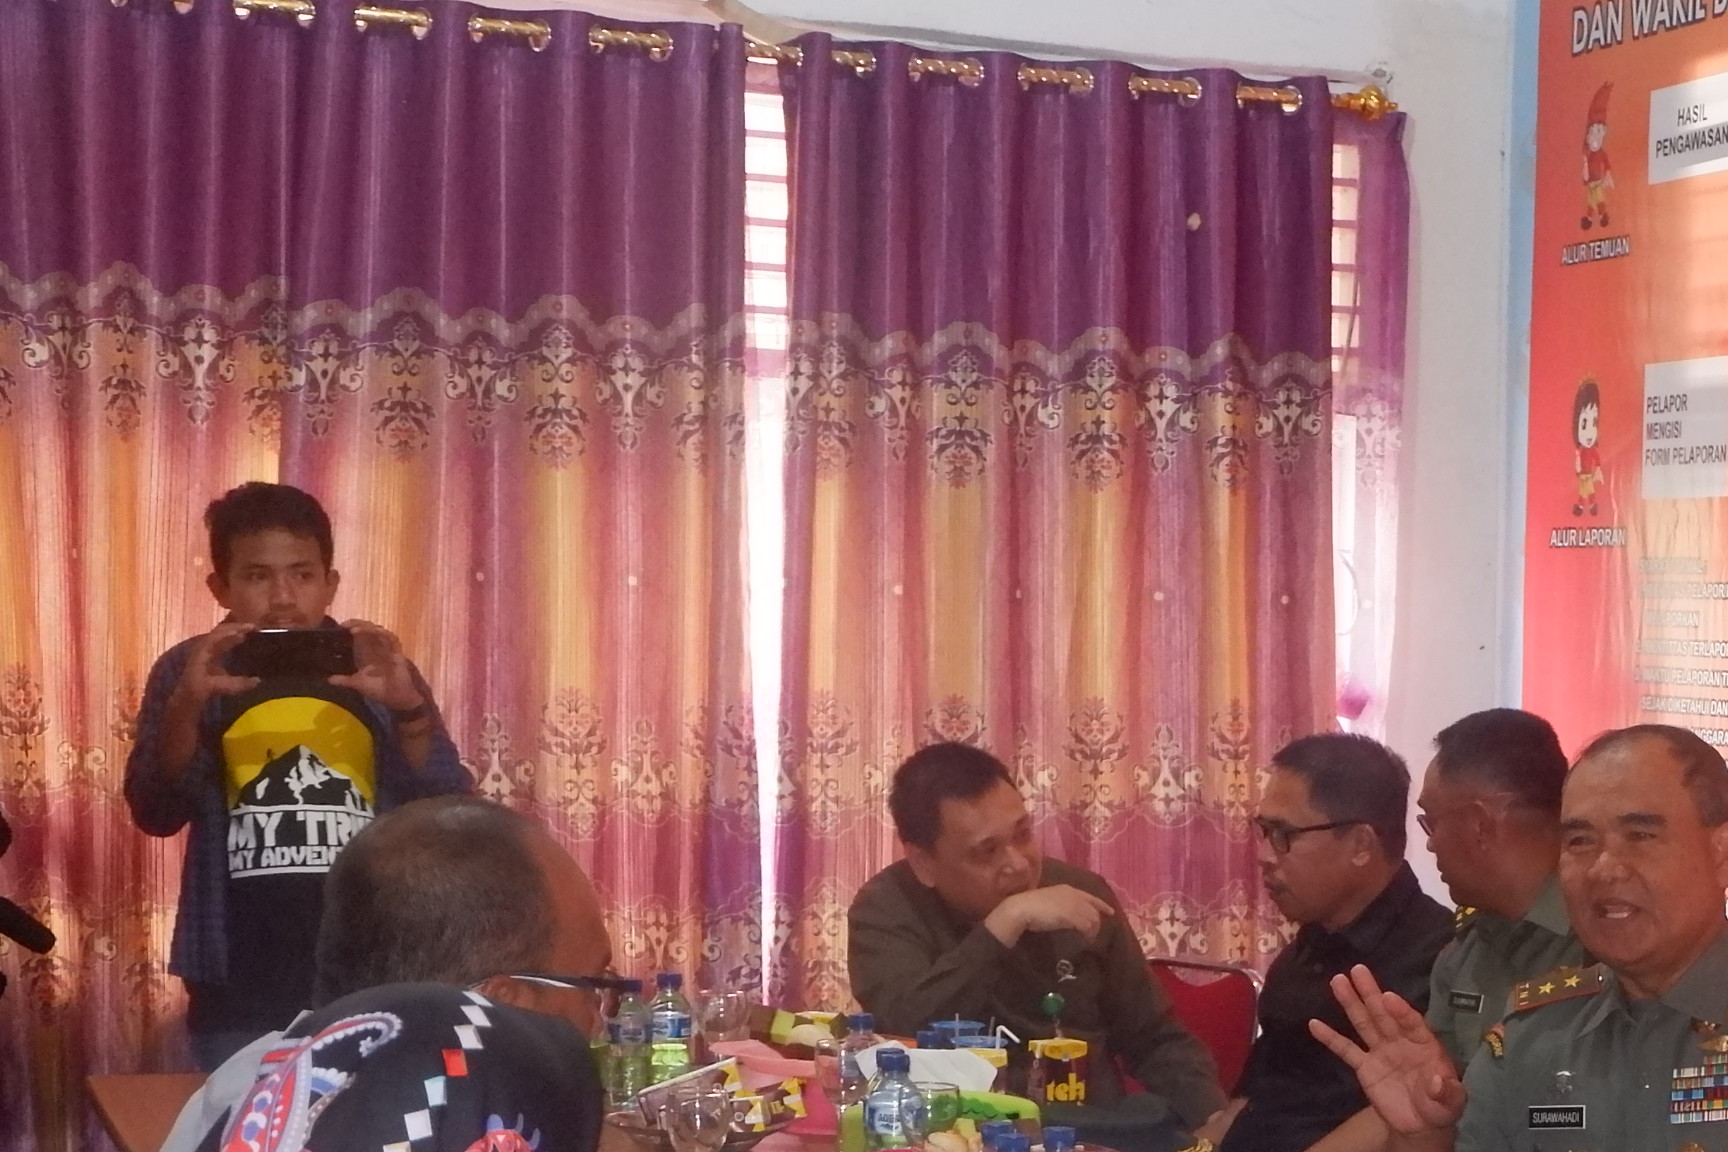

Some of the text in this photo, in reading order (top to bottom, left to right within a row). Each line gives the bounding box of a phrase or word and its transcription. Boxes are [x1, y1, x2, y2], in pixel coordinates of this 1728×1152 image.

[1572, 0, 1624, 54] DAN
[1677, 103, 1708, 128] HASIL
[1561, 237, 1631, 266] ALUR TEMUAN
[1646, 394, 1688, 414] PELAPOR
[1646, 421, 1682, 440] MENGISI
[1645, 445, 1727, 467] FORM PELAPORAN
[1550, 527, 1626, 548] ALUR LAPORAN
[1710, 699, 1728, 717] DAN
[228, 811, 284, 850] MY
[229, 851, 255, 872] MY
[1532, 1111, 1580, 1124] SURAWAHADI
